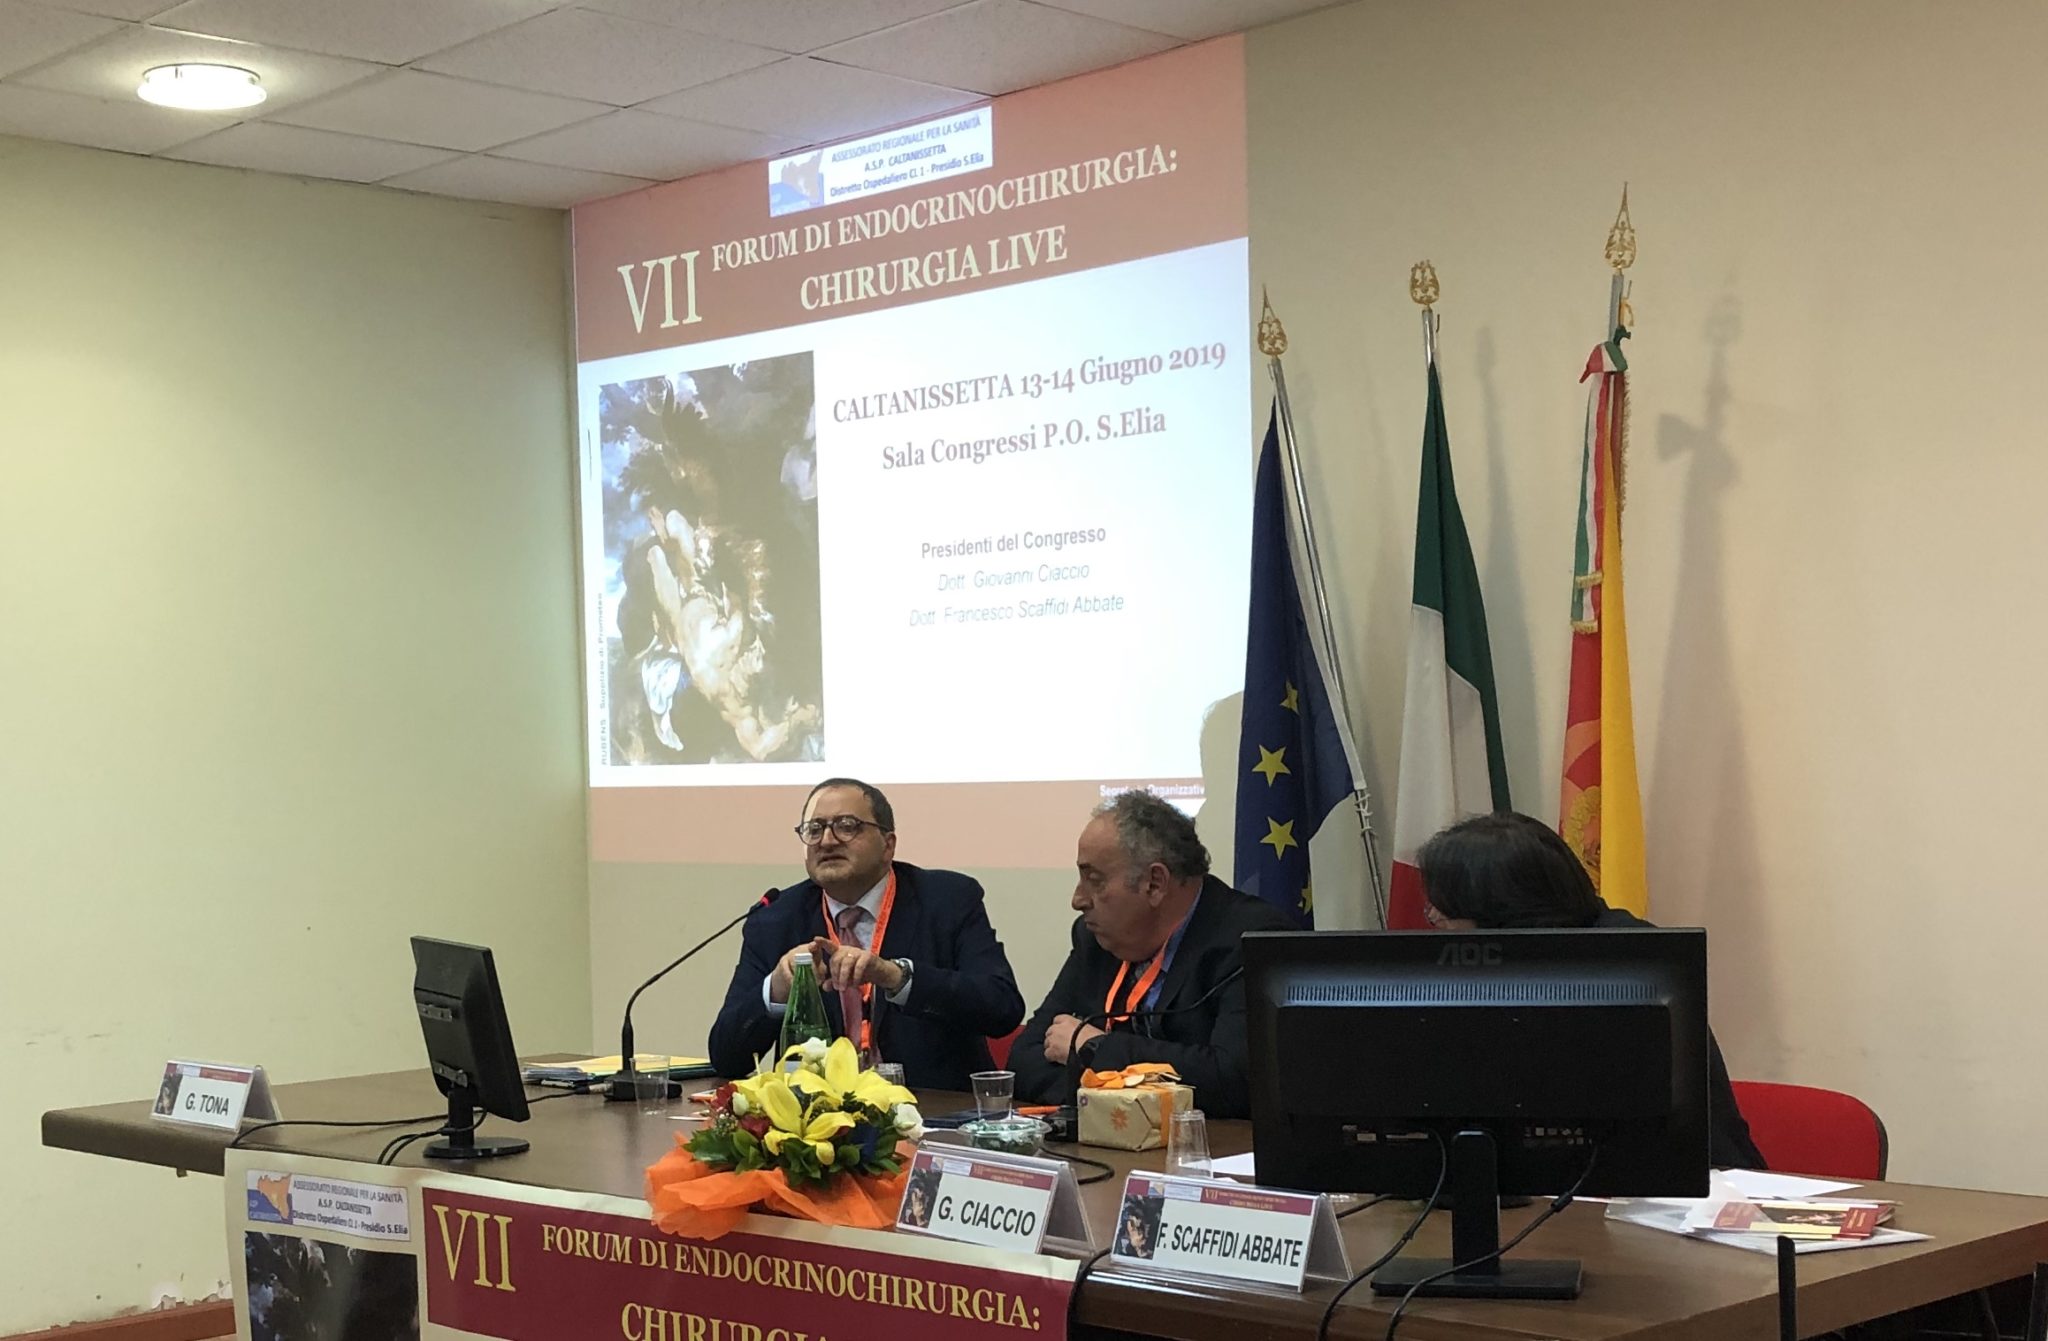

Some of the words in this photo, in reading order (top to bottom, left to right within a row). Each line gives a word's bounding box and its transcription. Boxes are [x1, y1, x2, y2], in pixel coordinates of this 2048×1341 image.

[831, 141, 882, 163] ASSESSORATO
[882, 129, 925, 154] REGIONALE
[926, 127, 941, 141] PER
[942, 124, 952, 136] LA
[954, 113, 982, 133] SANITÀ
[888, 143, 947, 168] CALTANISSETTA
[830, 181, 863, 198] Distretto
[863, 171, 908, 191] Ospedaliero
[919, 167, 925, 177] 1
[931, 158, 963, 174] Presidio
[712, 227, 799, 272] FORUM
[804, 220, 832, 253] DI
[838, 143, 1178, 246] ENDOCRINOCHIRURGIA:
[801, 244, 982, 311] CHIRURGIA
[987, 224, 1068, 276] LIVE
[617, 250, 702, 334] VII
[833, 373, 1014, 423] CALTANISSETTA
[1020, 367, 1076, 398] 13-14
[1079, 355, 1163, 386] Giugno
[1168, 342, 1227, 372] 2019
[882, 442, 926, 470] Sala
[930, 424, 1037, 465] Congressi
[1043, 418, 1091, 449] P.O.
[1096, 406, 1167, 441] S.Elia
[921, 535, 993, 559] Presidenti
[997, 532, 1019, 552] del
[1023, 527, 1107, 551] Congresso
[973, 569, 1034, 589] Giovanni
[1038, 563, 1090, 583] Ciaccio
[944, 603, 1014, 624] Francesco
[1017, 597, 1070, 619] Scaffidi
[1072, 594, 1125, 614] Abbate
[1148, 784, 1205, 797] Organizzativ
[1437, 943, 1502, 966] AOC
[185, 1092, 196, 1111] G.
[199, 1094, 230, 1116] TONA
[377, 1191, 404, 1204] SANITÀ
[938, 1195, 954, 1222] G.
[960, 1199, 1036, 1237] CIACCIO
[361, 1220, 386, 1234] Presidio
[1156, 1222, 1168, 1249] F.
[1171, 1224, 1240, 1258] SCAFFIDI
[1239, 1234, 1304, 1268] ABBATE
[432, 1204, 517, 1292] VII
[541, 1223, 633, 1264] FORUM
[639, 1238, 669, 1270] DI
[674, 1242, 1041, 1332] ENDOCRINOCHIRURGIA:
[621, 1302, 828, 1341] CHIRUR
